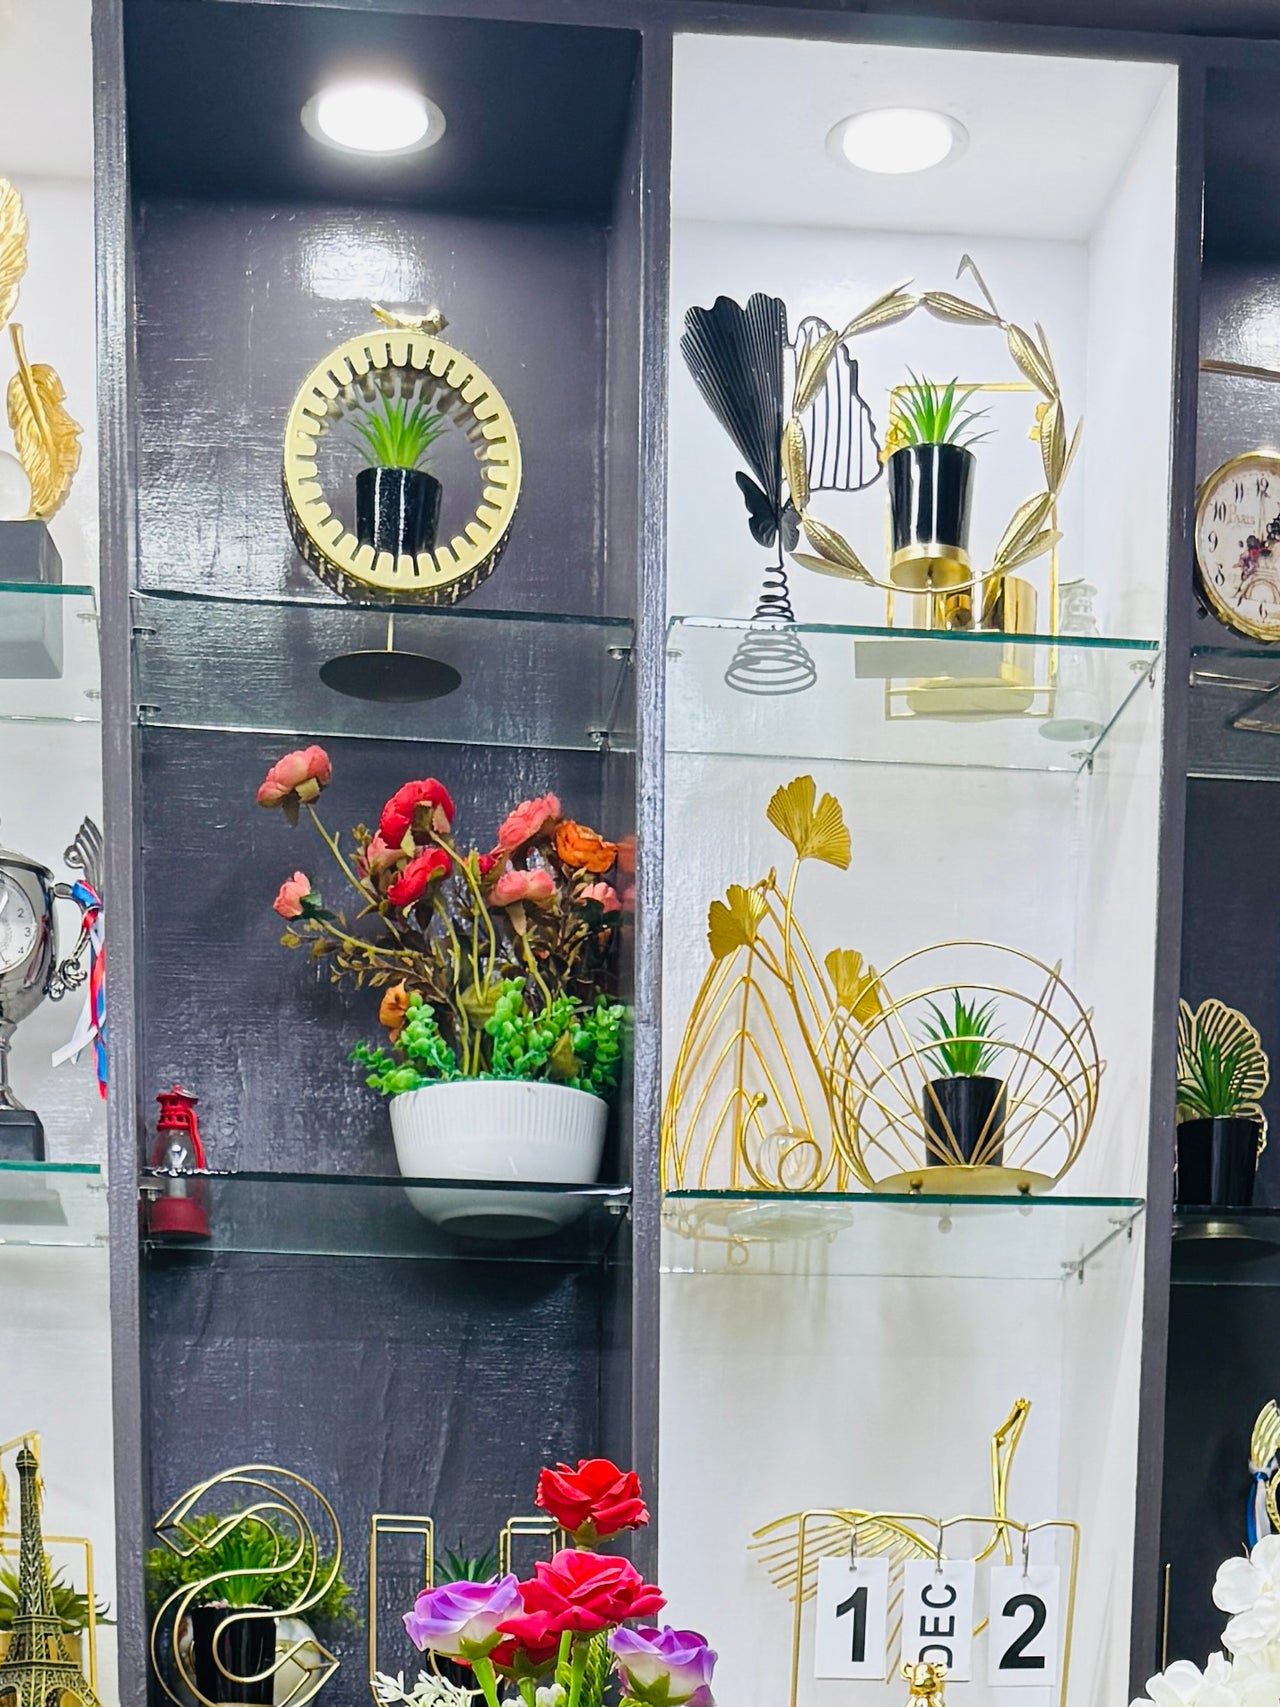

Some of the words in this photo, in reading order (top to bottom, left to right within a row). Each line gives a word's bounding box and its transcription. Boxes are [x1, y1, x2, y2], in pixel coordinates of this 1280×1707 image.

[1234, 481, 1244, 503] 11
[1255, 477, 1270, 498] 12
[1212, 500, 1227, 523] 10
[1207, 530, 1218, 553] 9
[1215, 563, 1225, 586] 8
[1259, 601, 1268, 623] 6
[17, 908, 24, 918] 2
[24, 927, 31, 937] 3
[835, 1586, 869, 1663] 1
[918, 1583, 957, 1669] DEC
[998, 1593, 1047, 1670] 2
